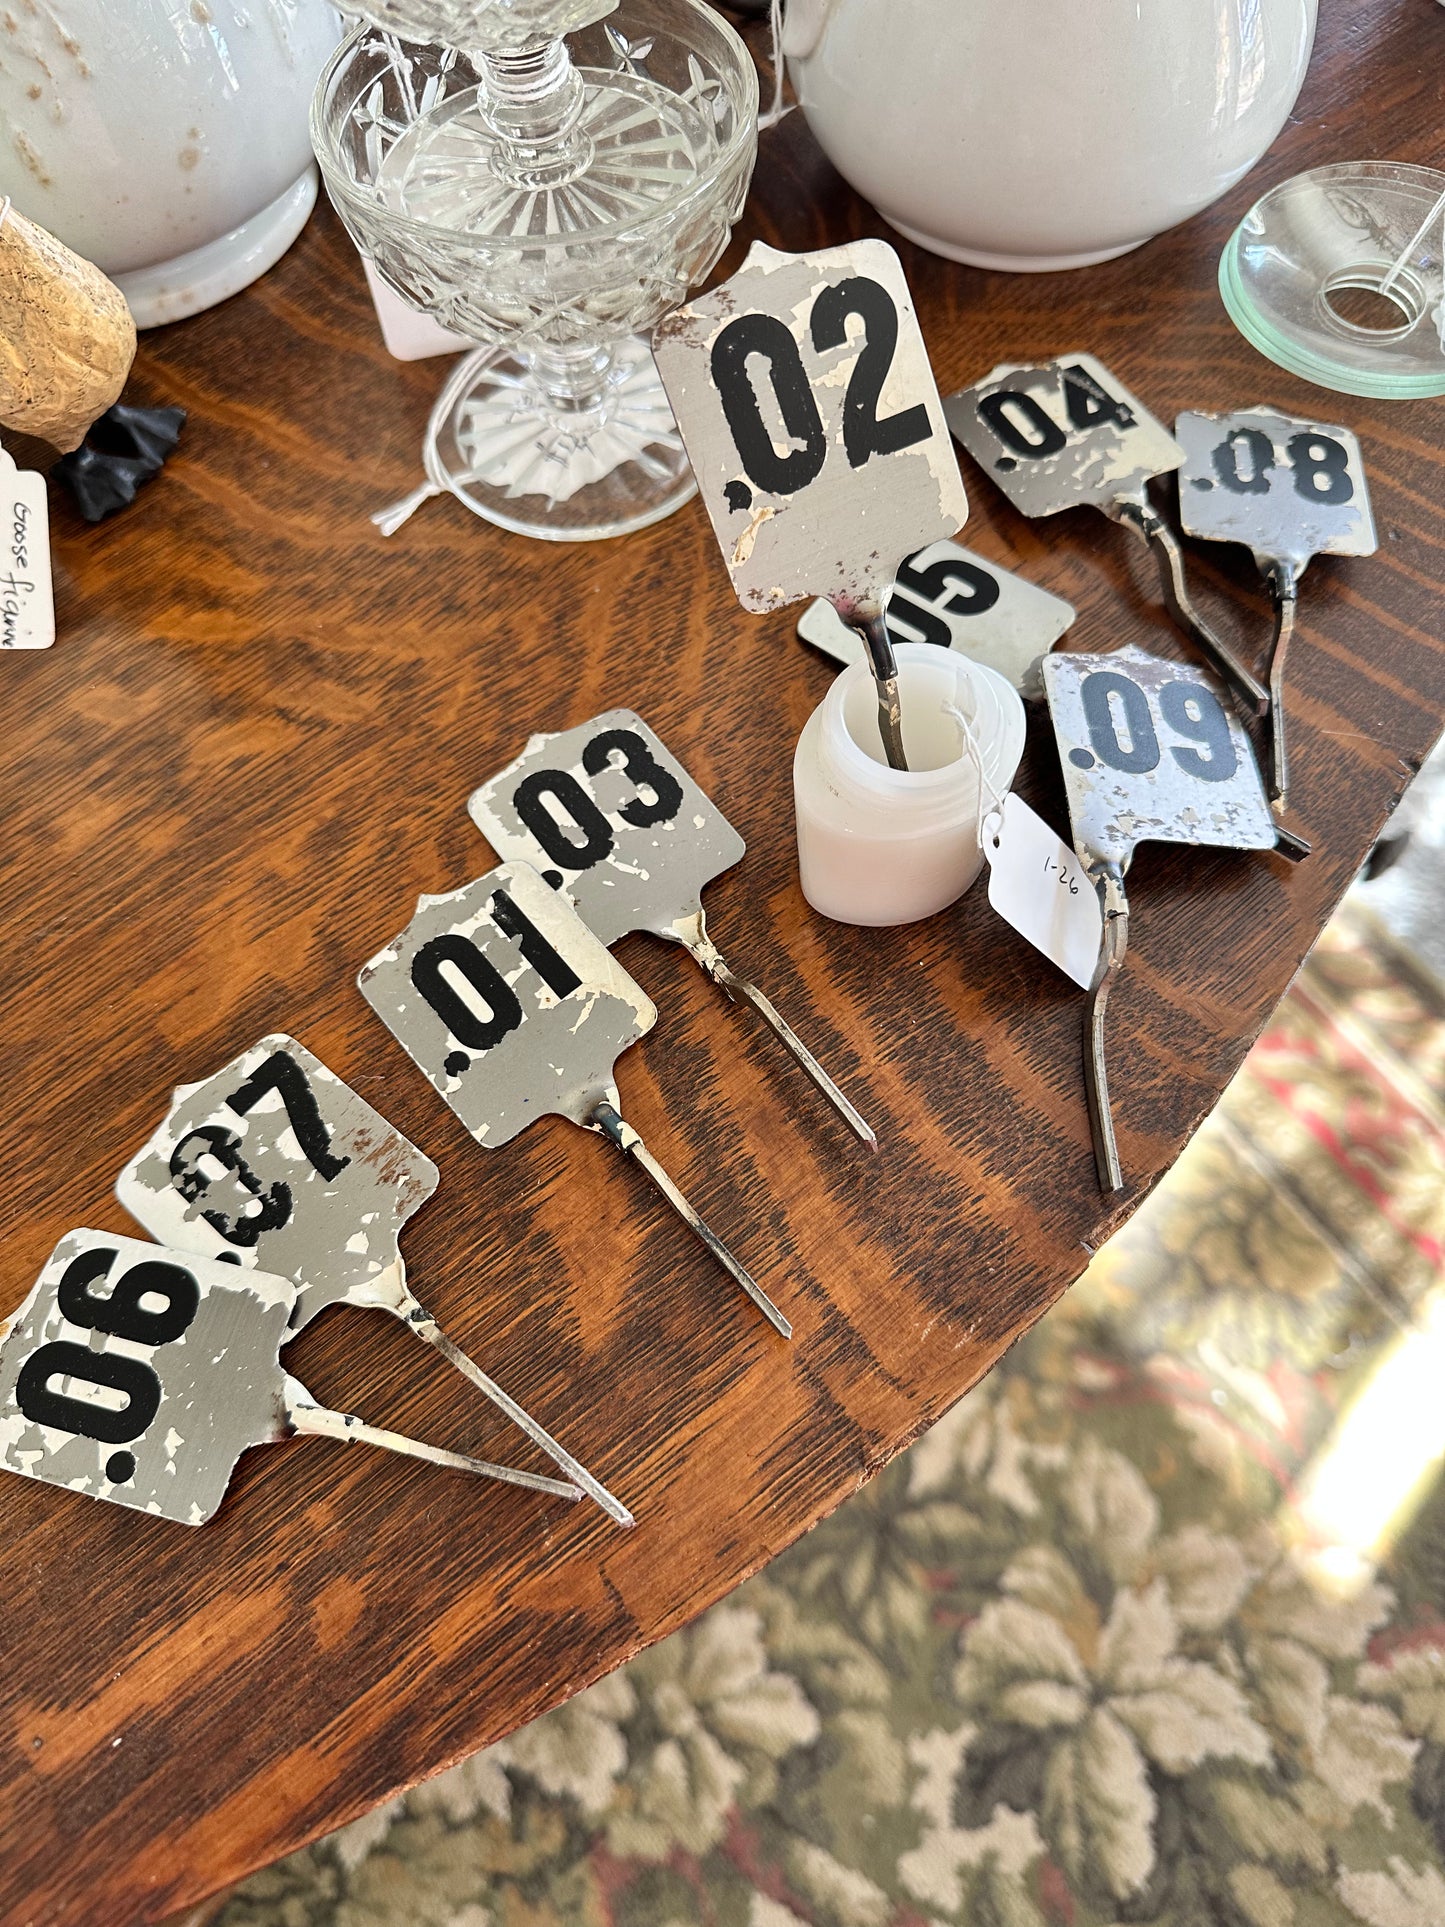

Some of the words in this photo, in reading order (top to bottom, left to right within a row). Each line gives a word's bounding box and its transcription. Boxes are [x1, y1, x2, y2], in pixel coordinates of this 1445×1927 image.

[711, 276, 933, 514] .02
[976, 365, 1138, 473] .04
[1191, 428, 1354, 505] .08
[11, 501, 33, 570] Goose
[1068, 671, 1237, 783] .09
[513, 729, 684, 892] .03
[1043, 855, 1079, 895] 1-26
[411, 888, 583, 1077] .01
[16, 1247, 201, 1484] .06
